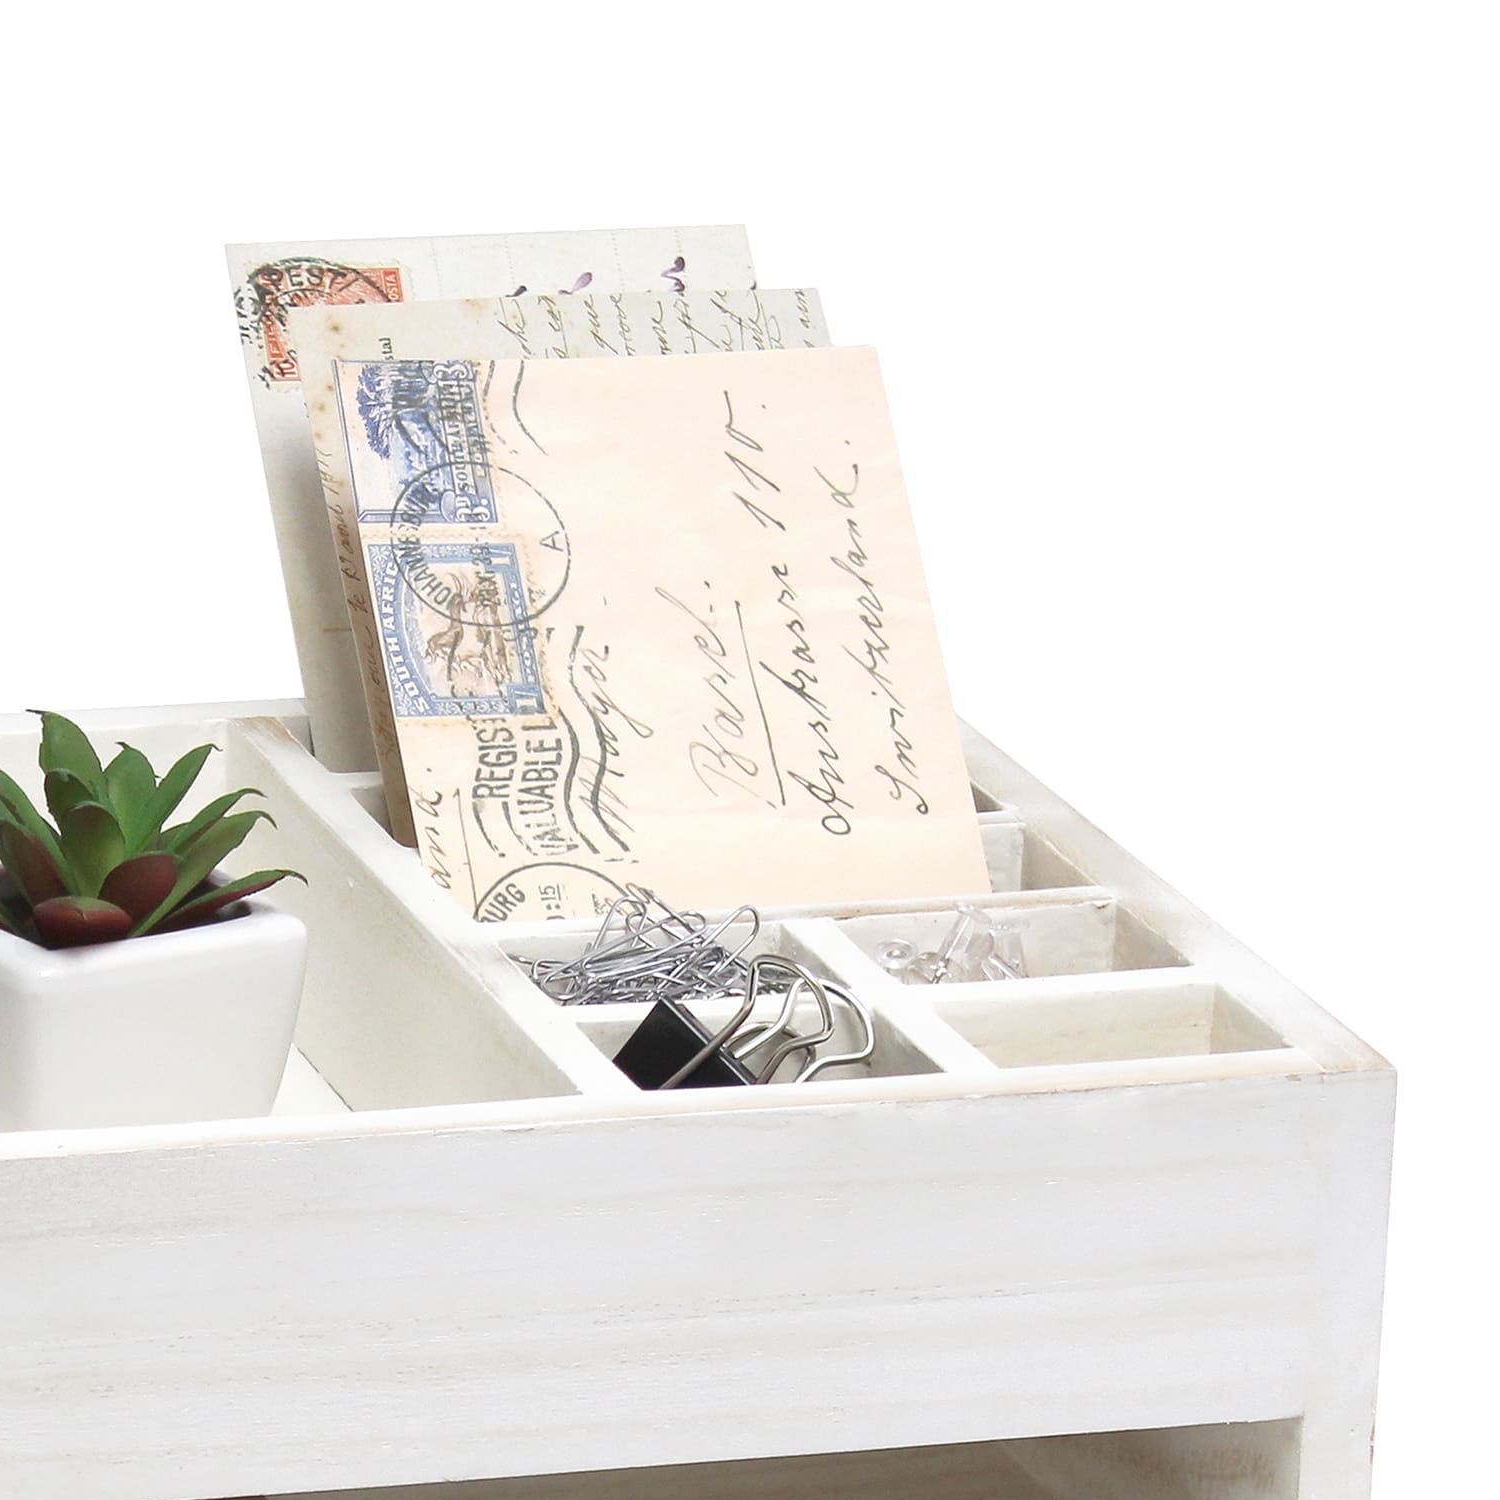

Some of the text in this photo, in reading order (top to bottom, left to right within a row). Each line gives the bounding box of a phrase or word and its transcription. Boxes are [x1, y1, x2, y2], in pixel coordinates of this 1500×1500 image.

[540, 530, 563, 553] A
[385, 638, 431, 714] SOUTH
[518, 737, 579, 855] VALUABLE
